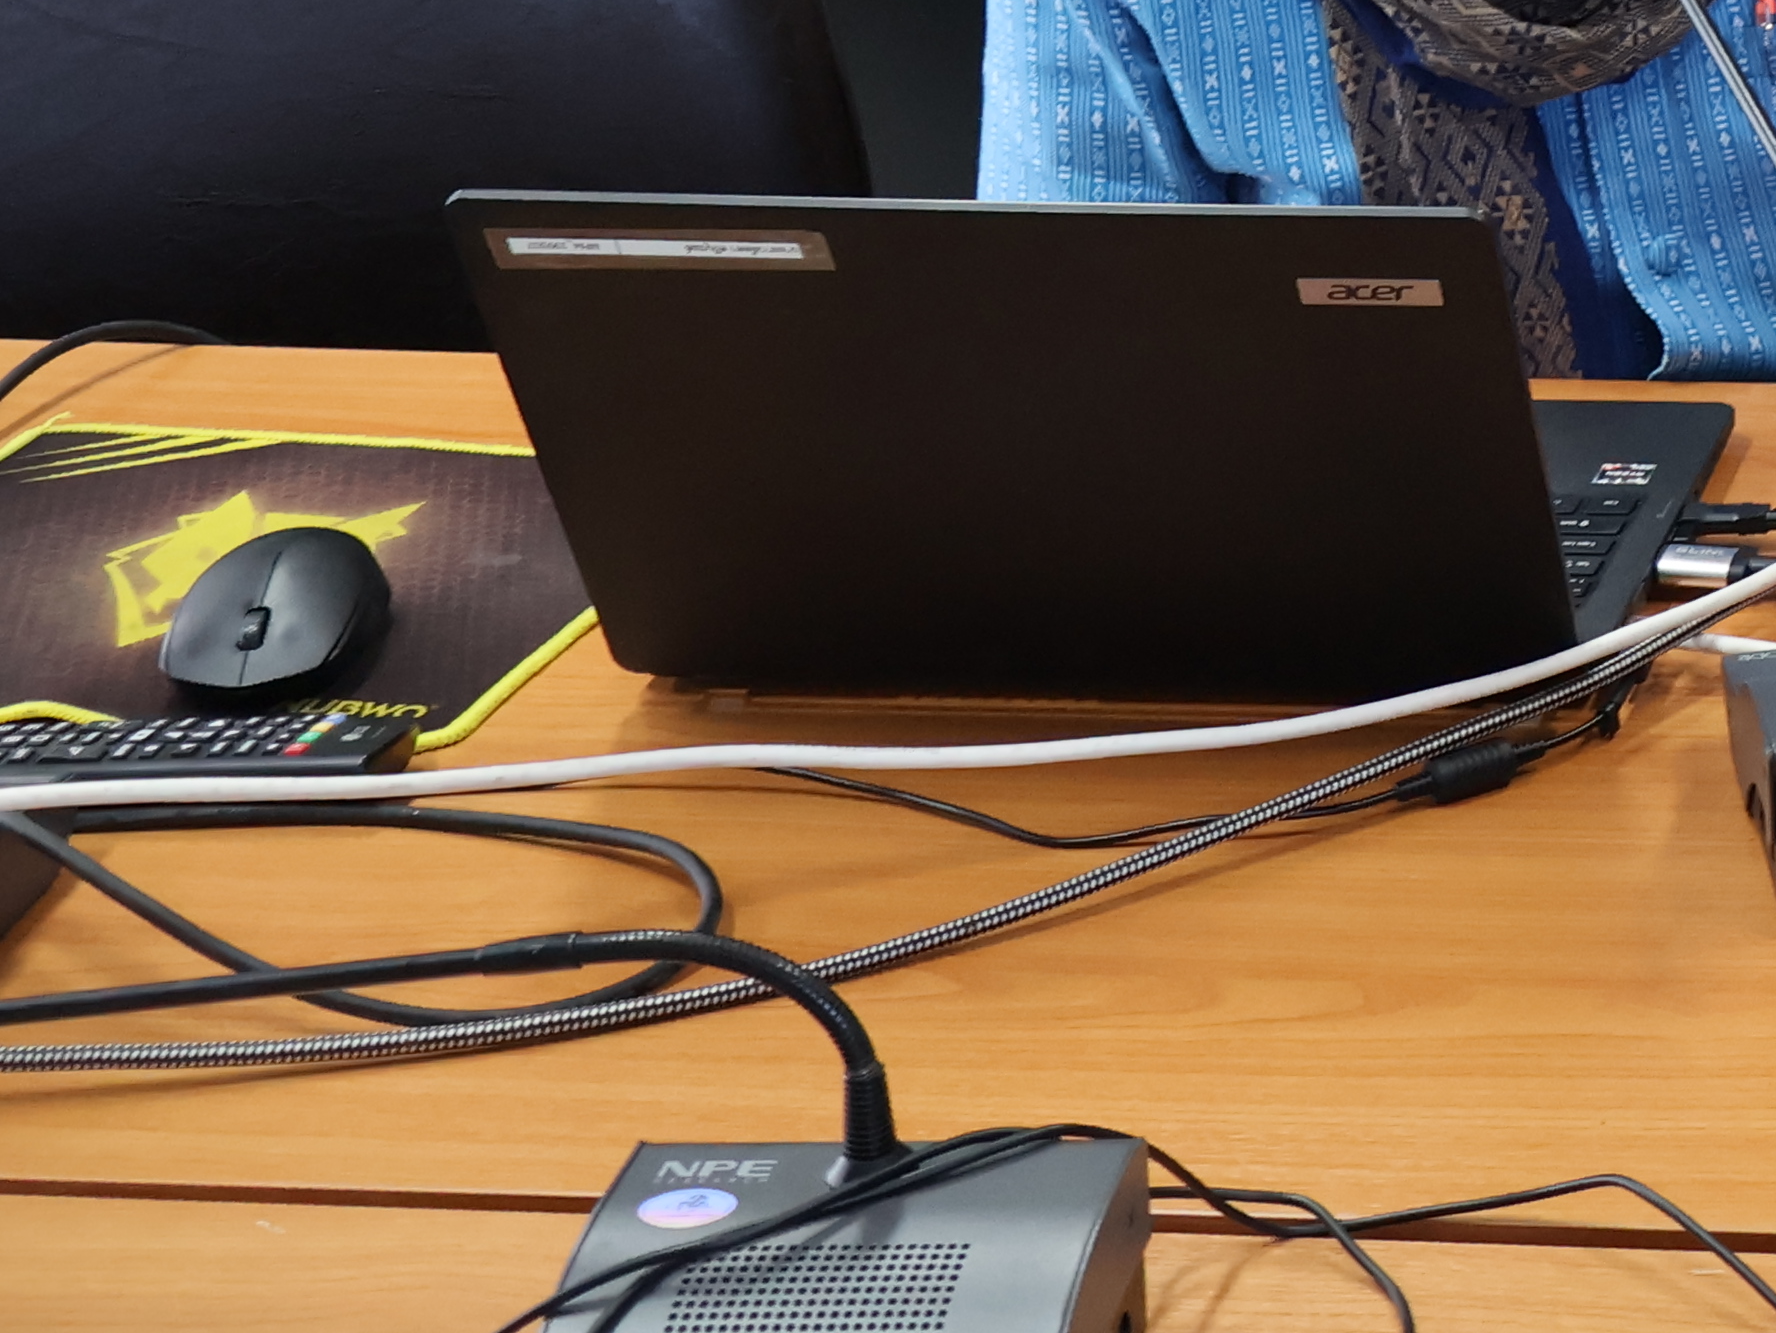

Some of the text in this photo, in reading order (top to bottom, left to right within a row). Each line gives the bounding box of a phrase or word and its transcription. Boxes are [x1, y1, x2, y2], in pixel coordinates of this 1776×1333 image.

[1326, 284, 1414, 302] acer
[286, 698, 429, 719] UBWO
[656, 1158, 779, 1178] NPE
